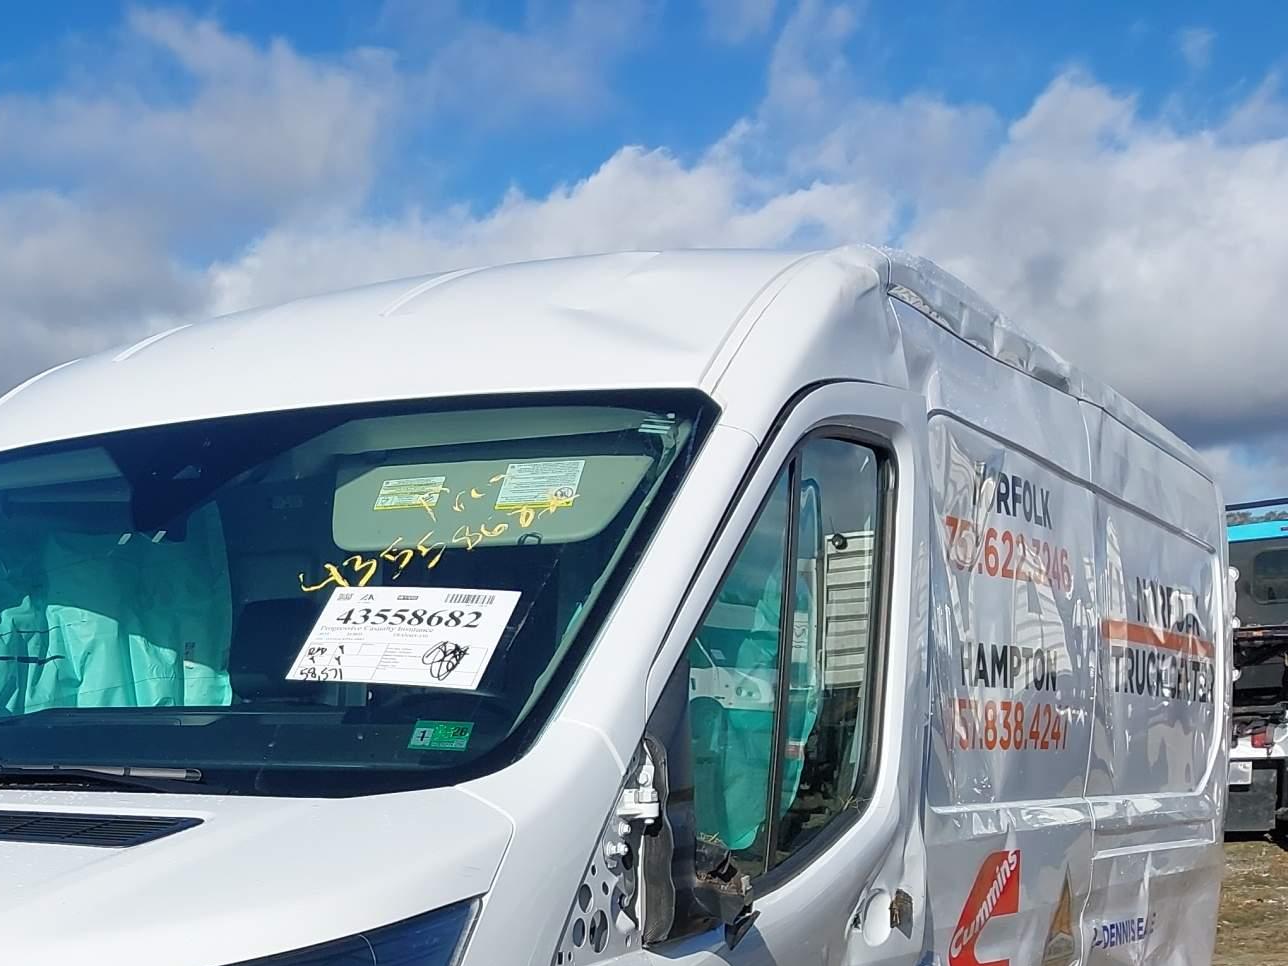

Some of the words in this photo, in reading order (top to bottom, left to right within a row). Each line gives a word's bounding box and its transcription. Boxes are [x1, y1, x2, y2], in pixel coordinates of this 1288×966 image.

[972, 463, 1052, 530] NRFOLK
[336, 608, 483, 628] 43558682
[960, 641, 1058, 692] HAMPTON
[1111, 645, 1166, 697] TRUCK
[951, 849, 1018, 958] Cummins
[1102, 919, 1136, 950] DENNIS
